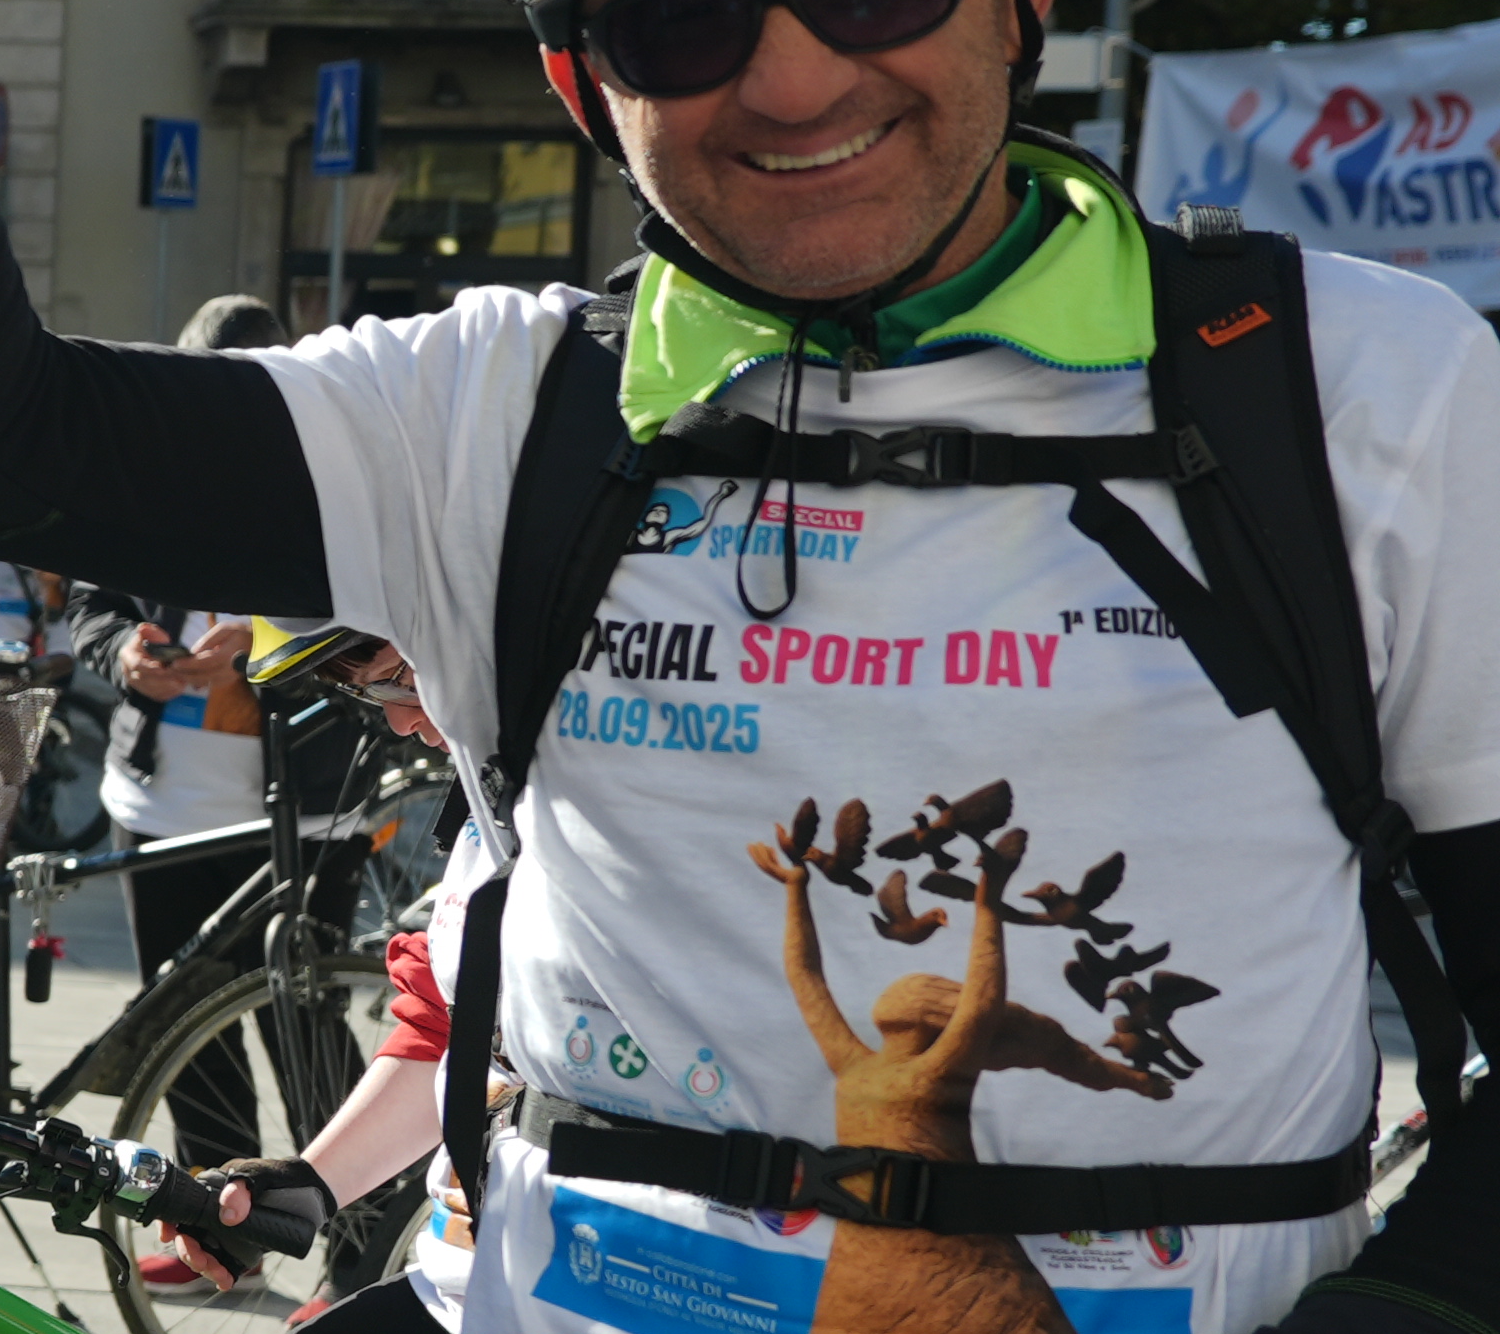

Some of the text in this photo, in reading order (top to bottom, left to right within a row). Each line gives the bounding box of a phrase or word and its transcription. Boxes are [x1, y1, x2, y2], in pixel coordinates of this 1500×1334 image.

[1396, 89, 1474, 156] AD
[1374, 159, 1500, 229] ASTR
[766, 504, 857, 530] SECIAL
[739, 623, 924, 686] SPORT
[944, 629, 1060, 688] DAY
[1094, 606, 1180, 640] EDIZIO
[557, 689, 761, 754] 28.09.2025
[603, 1268, 650, 1296] SESTO
[652, 1284, 684, 1308] SAN
[687, 1295, 777, 1334] GIOVANNI
[702, 1280, 723, 1299] DI
